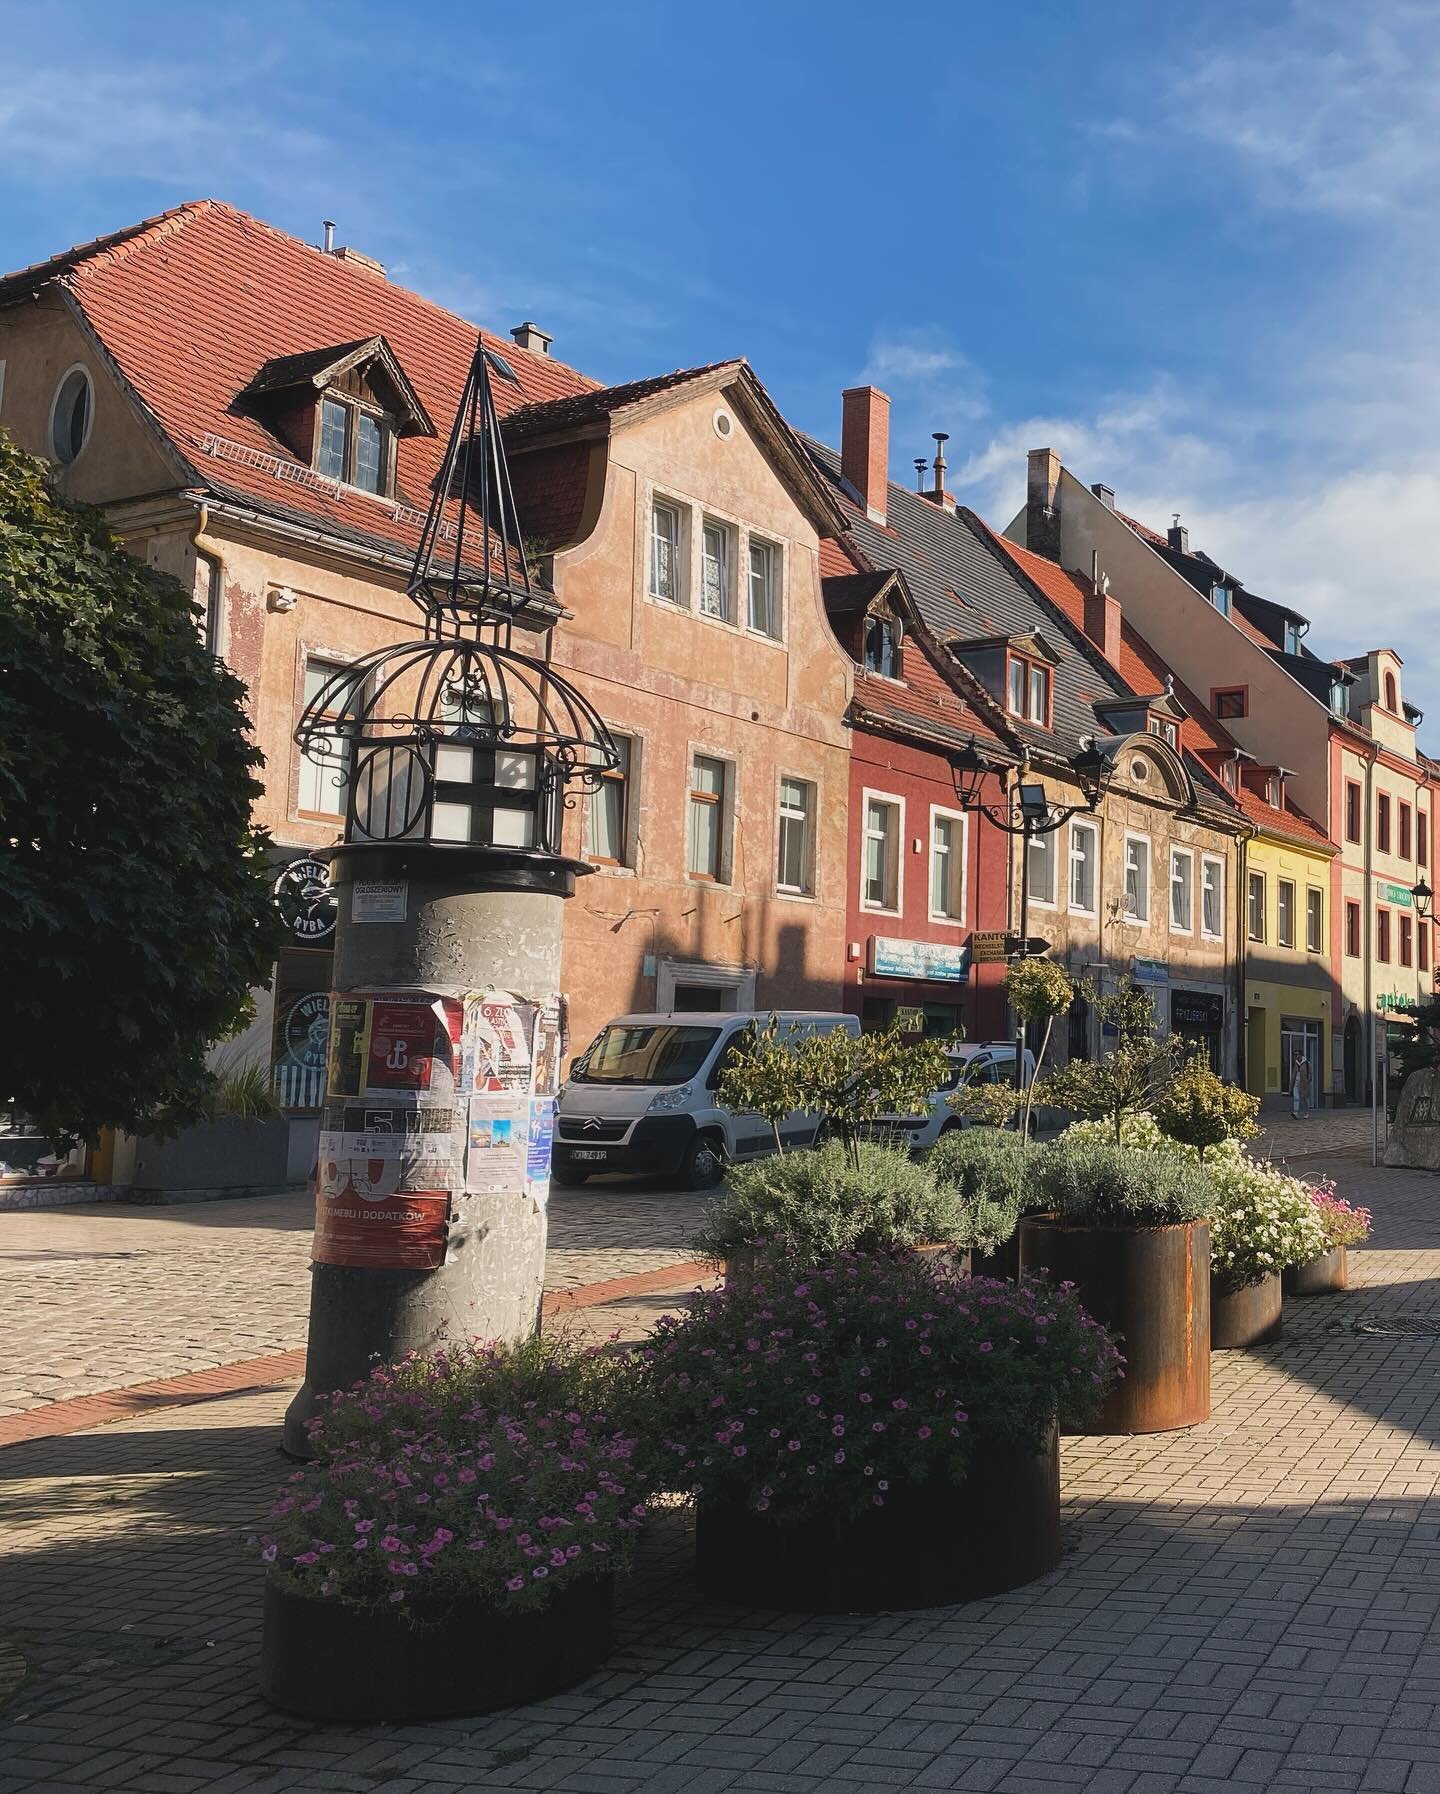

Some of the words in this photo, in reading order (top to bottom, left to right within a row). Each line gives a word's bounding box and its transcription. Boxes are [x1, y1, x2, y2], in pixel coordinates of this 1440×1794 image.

[293, 916, 326, 932] RYBA
[300, 999, 329, 1017] WIEL
[304, 1050, 326, 1065] RYB
[363, 1210, 425, 1221] DODATKÓW
